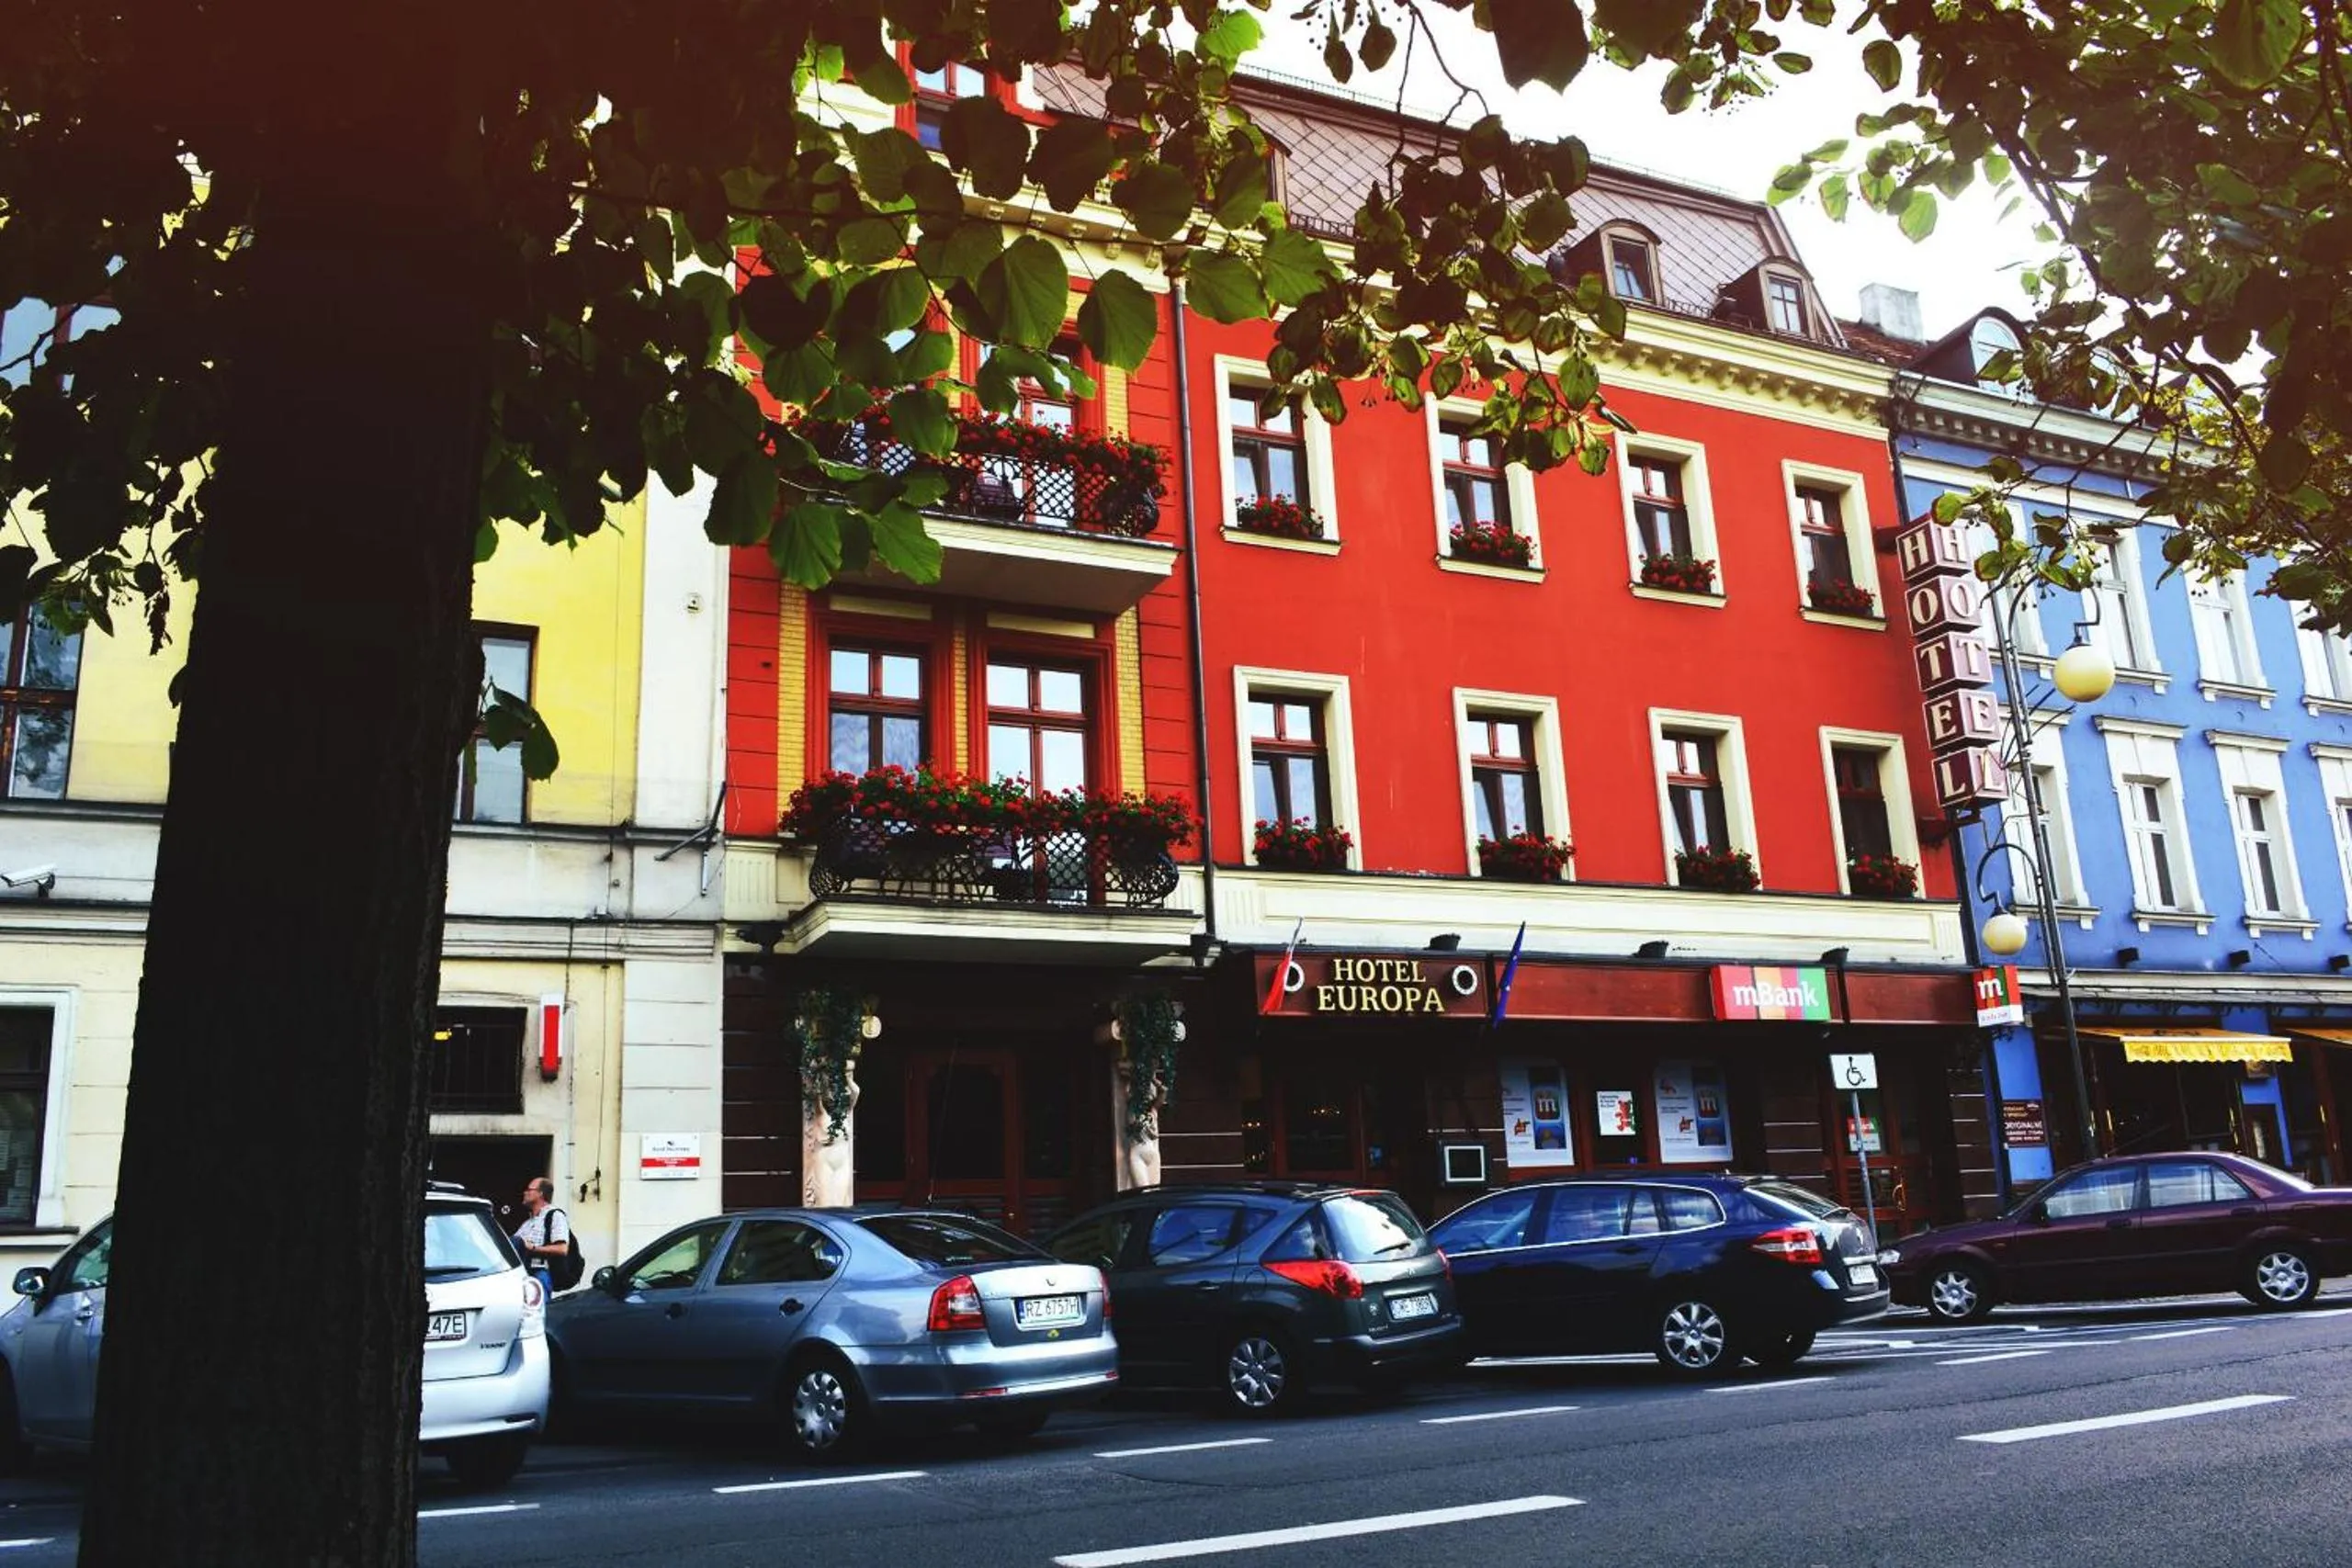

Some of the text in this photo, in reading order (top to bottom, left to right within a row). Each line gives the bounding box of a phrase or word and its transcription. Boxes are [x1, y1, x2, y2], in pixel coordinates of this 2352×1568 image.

[1901, 529, 1966, 799] HOTEL
[1938, 525, 2007, 792] HOTEL
[1333, 958, 1427, 983] HOTEL
[1317, 985, 1445, 1012] EUROPA
[1732, 981, 1819, 1008] mBank
[1977, 977, 2004, 1000] m
[1538, 1098, 1557, 1112] m
[428, 1314, 463, 1334] 47E
